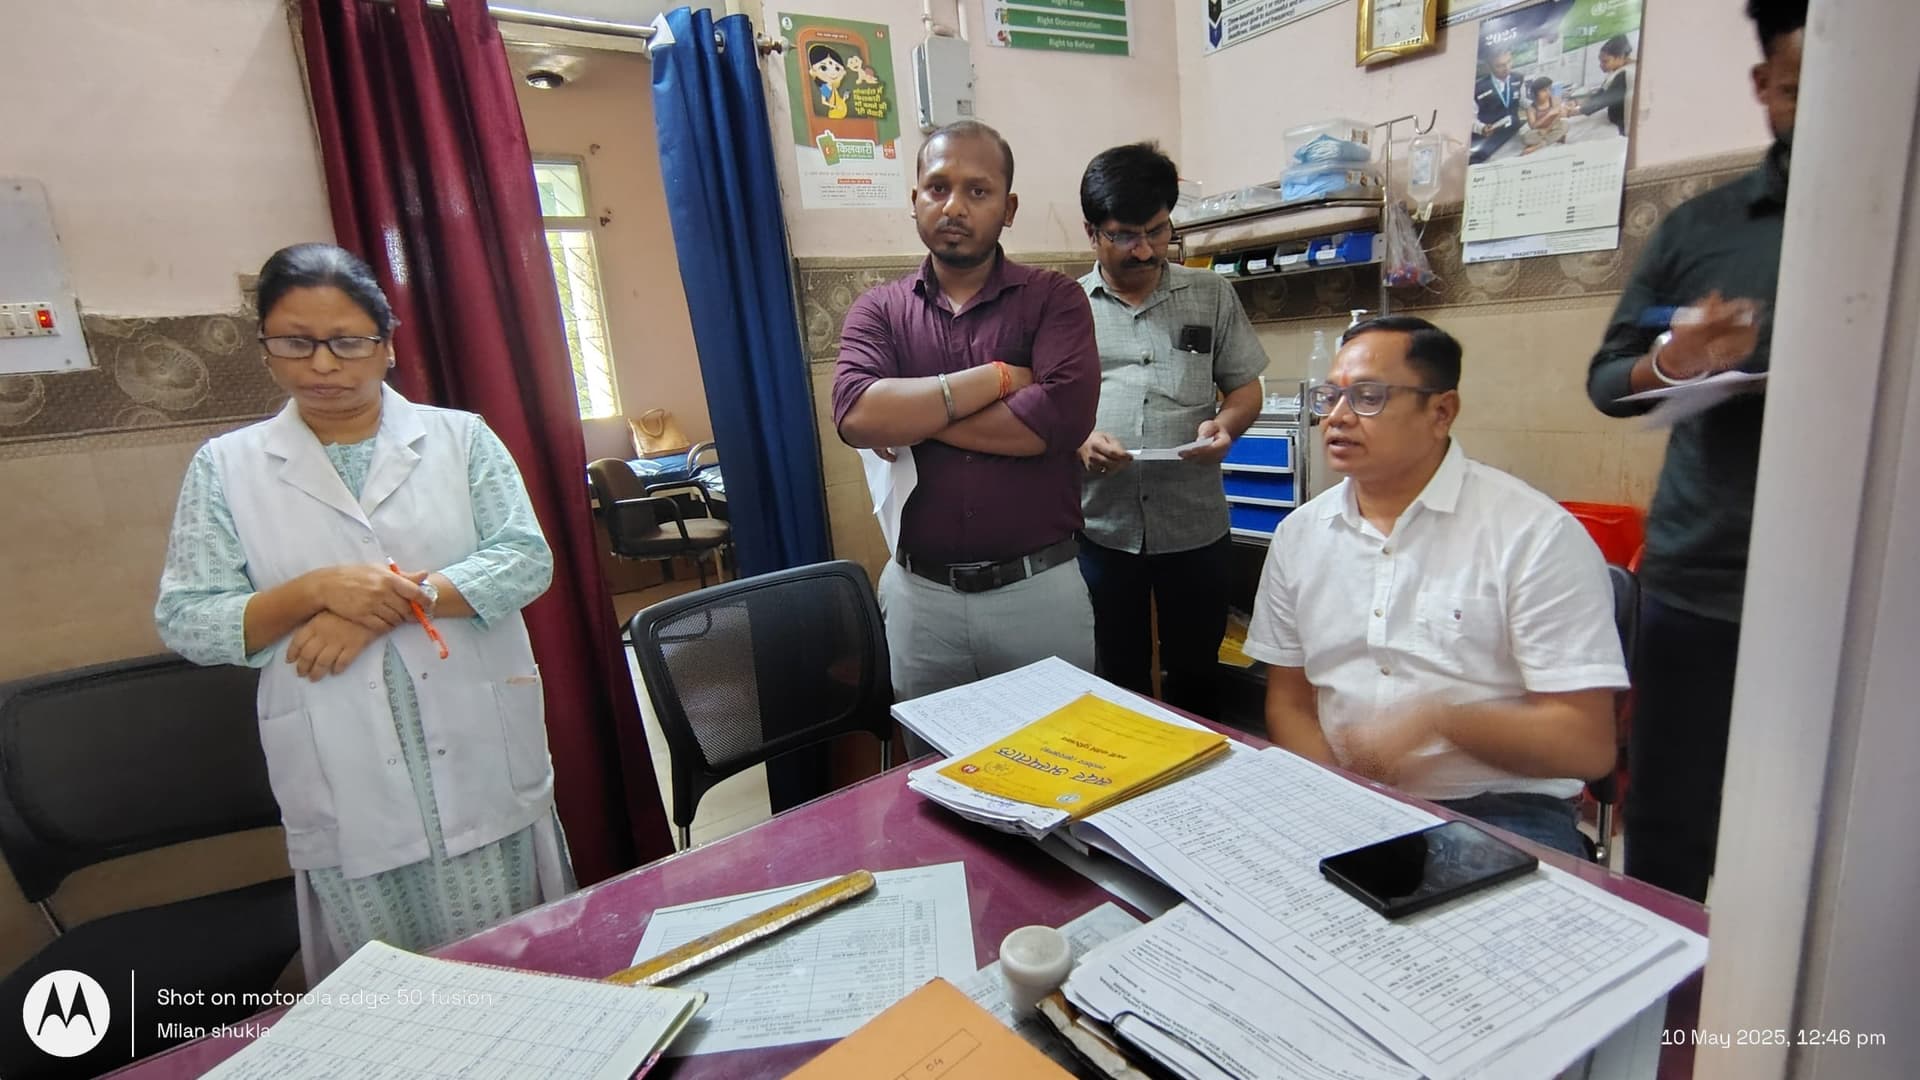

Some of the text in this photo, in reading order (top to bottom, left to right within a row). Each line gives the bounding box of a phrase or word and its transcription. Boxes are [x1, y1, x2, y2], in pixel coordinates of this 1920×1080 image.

[1037, 16, 1102, 29] Right Documentation
[1485, 27, 1518, 46] 2025
[1049, 38, 1095, 49] Right to Refuse
